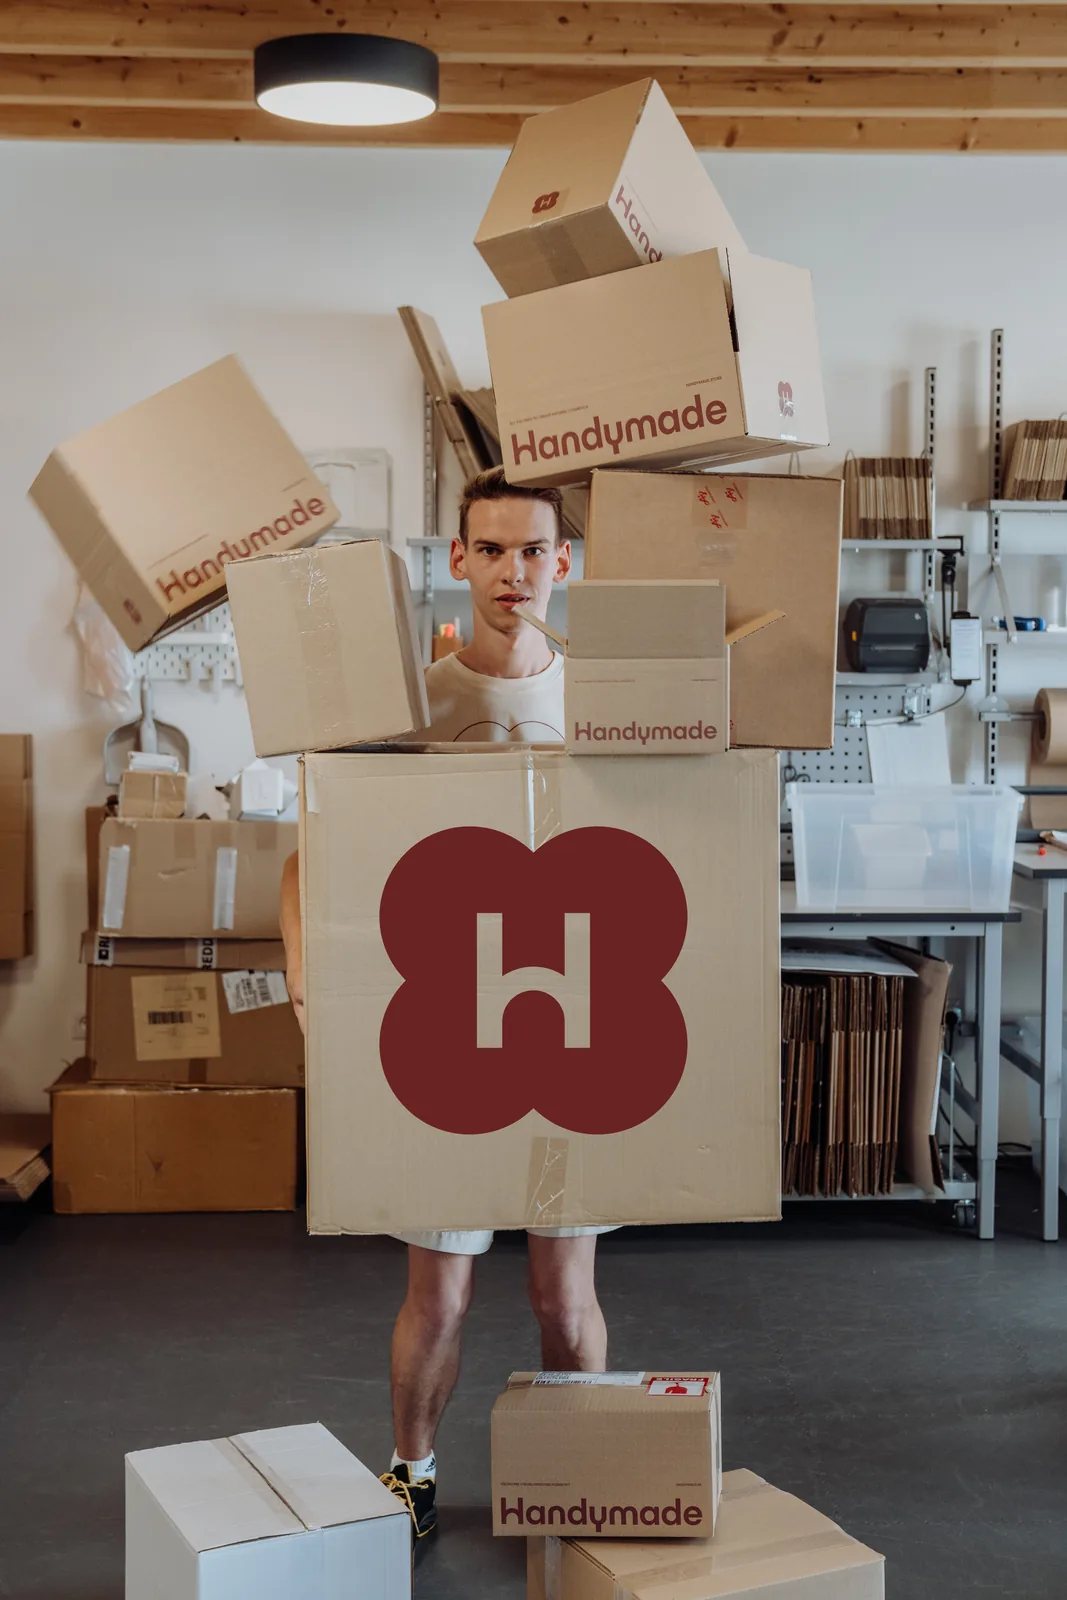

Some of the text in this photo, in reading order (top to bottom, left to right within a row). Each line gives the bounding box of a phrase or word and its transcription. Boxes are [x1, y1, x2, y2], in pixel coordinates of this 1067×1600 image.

[511, 393, 728, 466] Handymade
[574, 719, 718, 746] Handymade
[477, 903, 590, 1048] H
[500, 1497, 703, 1532] Handymade
